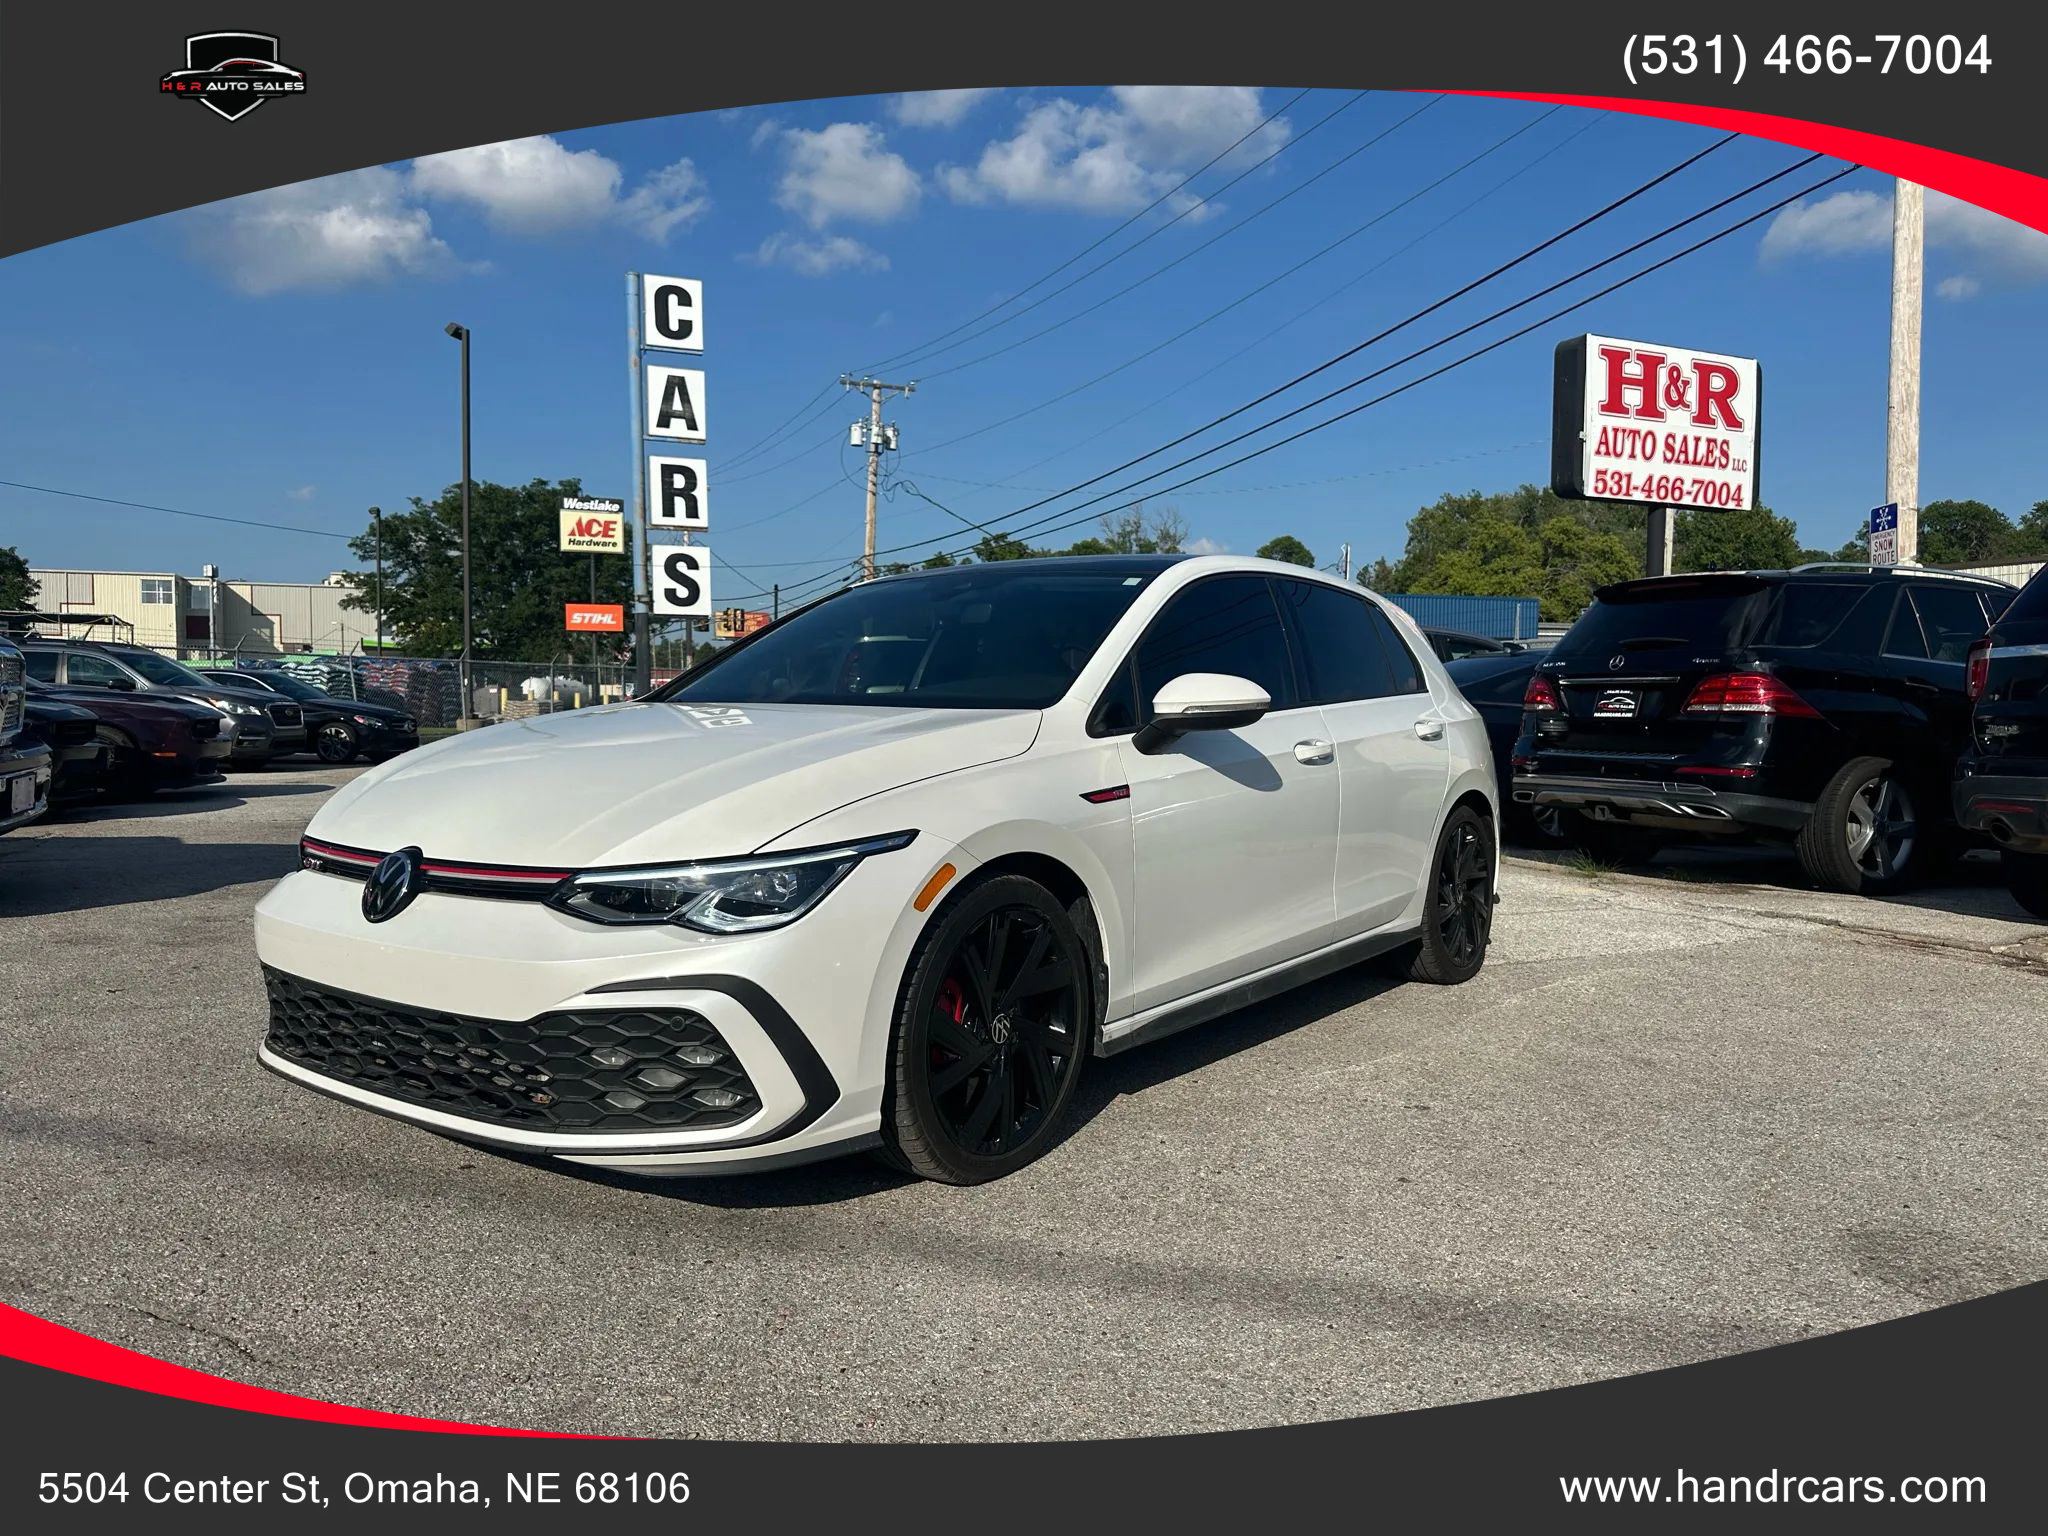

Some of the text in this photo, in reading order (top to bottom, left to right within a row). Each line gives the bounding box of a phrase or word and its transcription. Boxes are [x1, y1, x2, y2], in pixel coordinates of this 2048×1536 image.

[1598, 344, 1744, 432] H&R
[1594, 425, 1748, 473] AUTO SALES LLC
[1593, 468, 1744, 508] 531-466-7004
[563, 497, 620, 512] Westlake
[567, 515, 618, 538] ACE
[568, 538, 618, 549] Hardware
[1874, 539, 1893, 553] SNOW
[1872, 550, 1895, 566] ROUTE
[570, 612, 617, 625] STIHL
